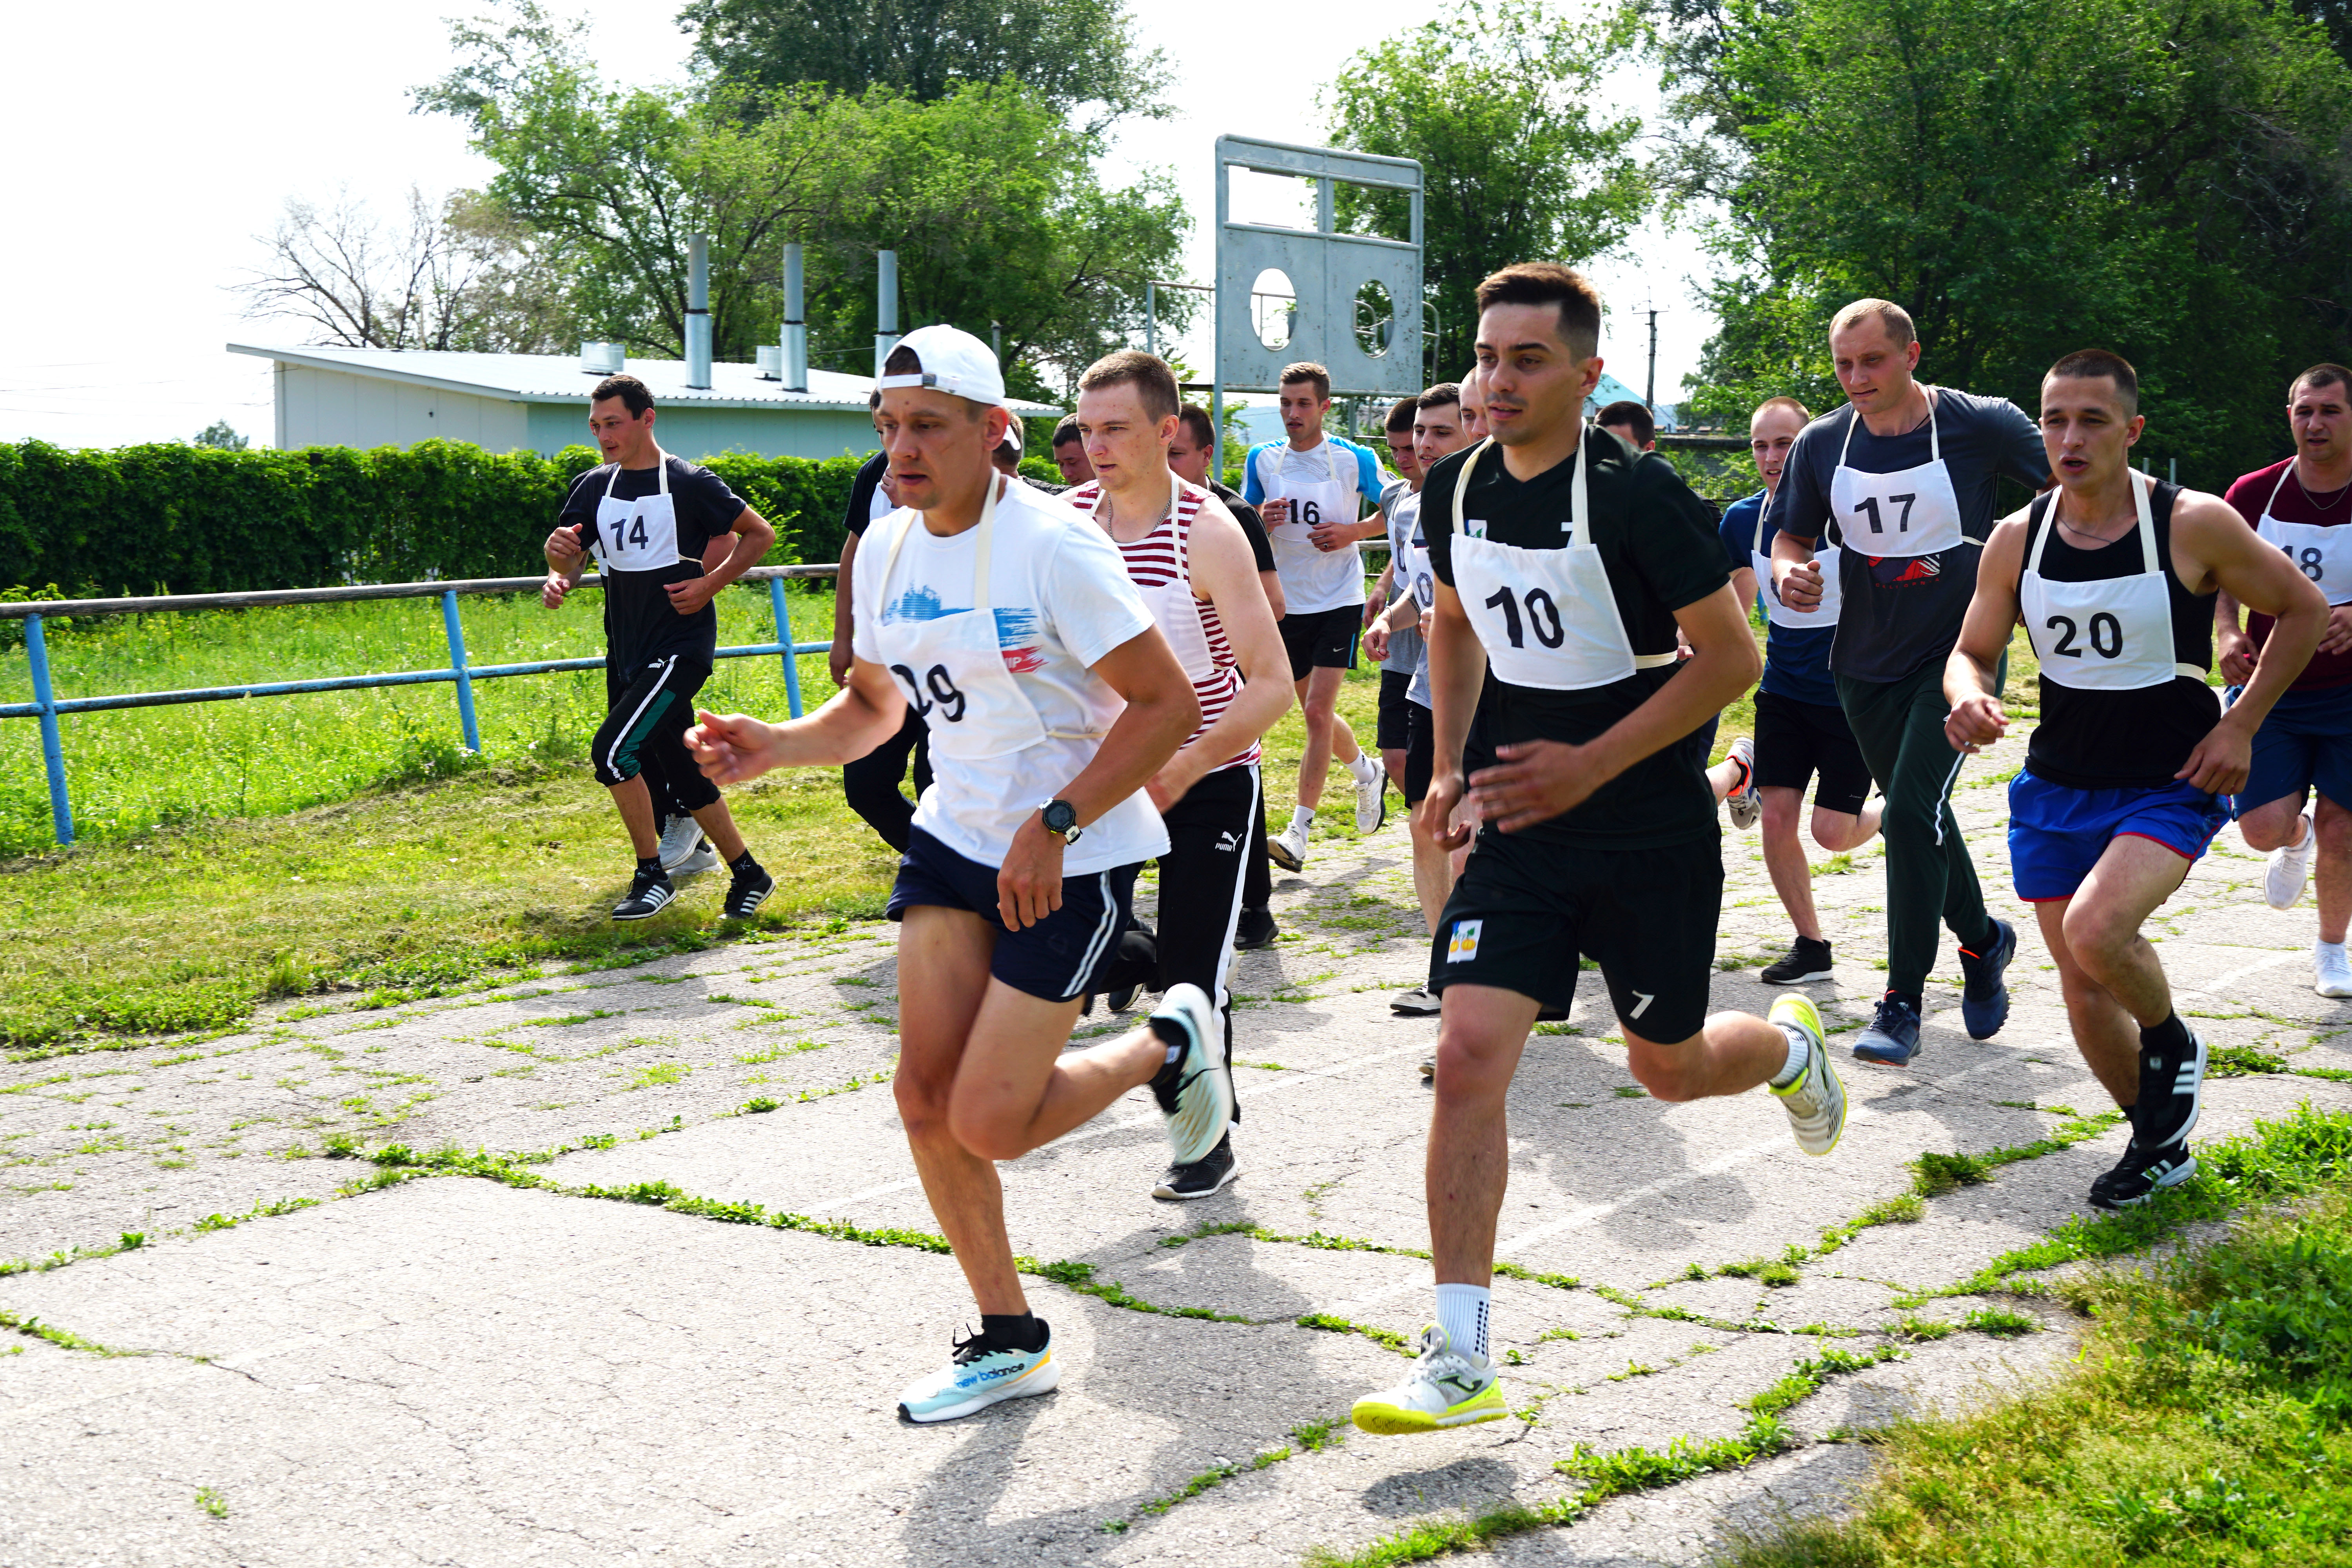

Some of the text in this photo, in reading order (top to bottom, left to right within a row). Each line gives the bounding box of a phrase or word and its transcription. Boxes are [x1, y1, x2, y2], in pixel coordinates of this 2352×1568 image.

[1282, 499, 1320, 525] 16
[1854, 493, 1916, 534] 17
[2281, 545, 2323, 582] 18
[1485, 586, 1565, 649] 10
[2047, 612, 2123, 659] 20
[1215, 842, 1233, 852] PUMA
[1629, 990, 1655, 1020] 7
[956, 1363, 1025, 1389] new balance
